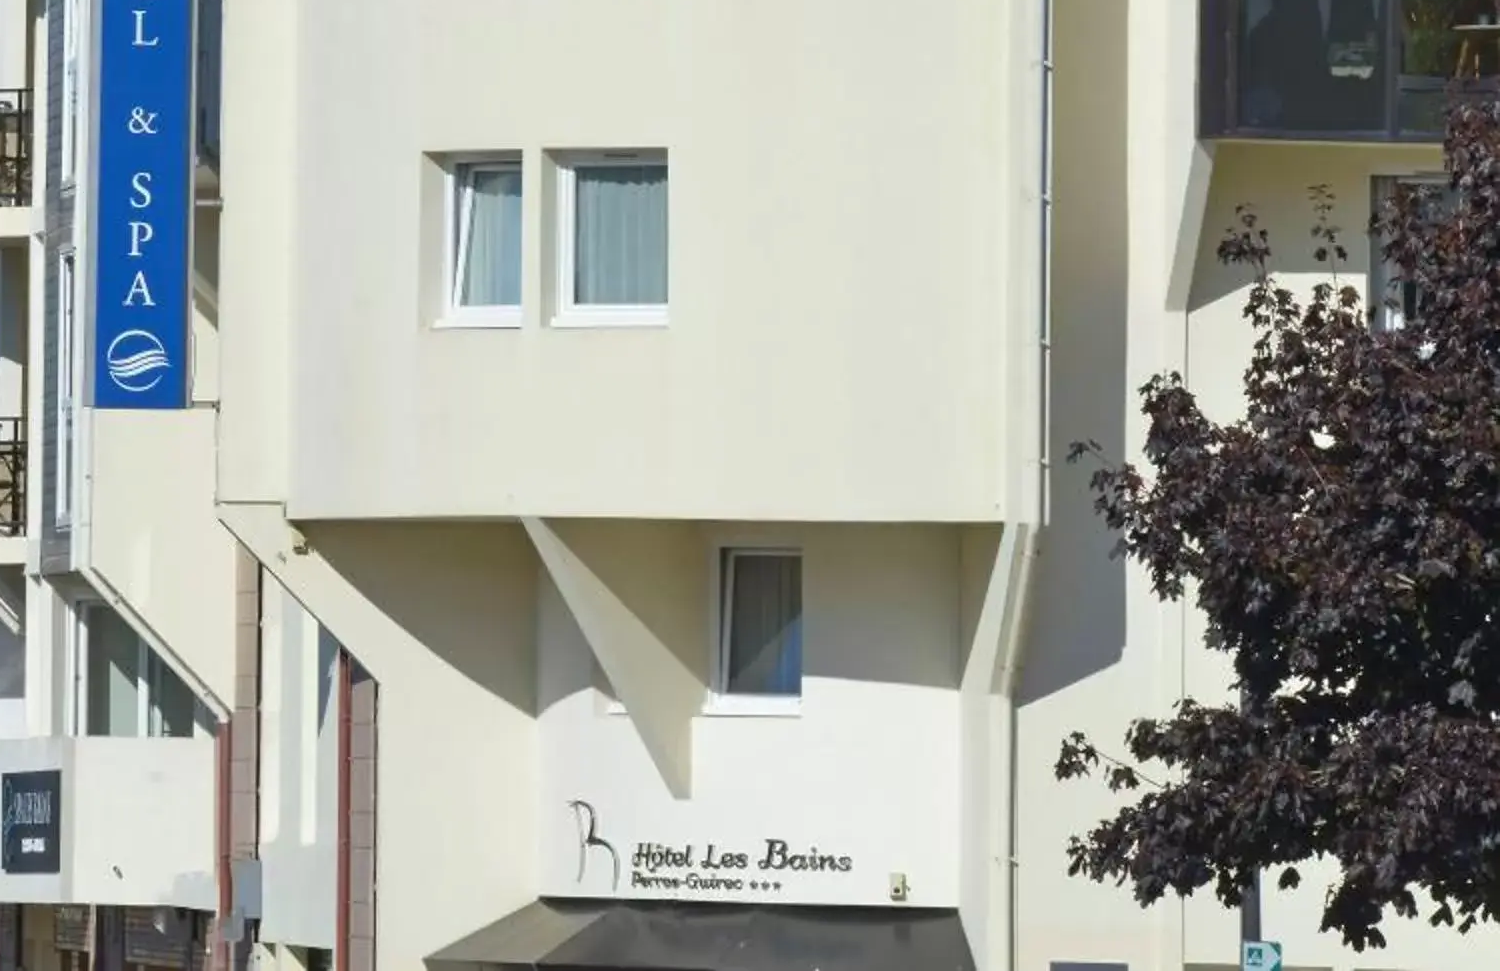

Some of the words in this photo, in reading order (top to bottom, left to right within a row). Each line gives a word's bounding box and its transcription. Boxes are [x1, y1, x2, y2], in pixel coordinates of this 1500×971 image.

[128, 107, 157, 134] &
[124, 172, 156, 307] SPA
[631, 842, 693, 874] Hôtel
[700, 844, 749, 870] Les
[757, 838, 853, 872] Bains
[631, 871, 744, 890] Perros-Guirec
